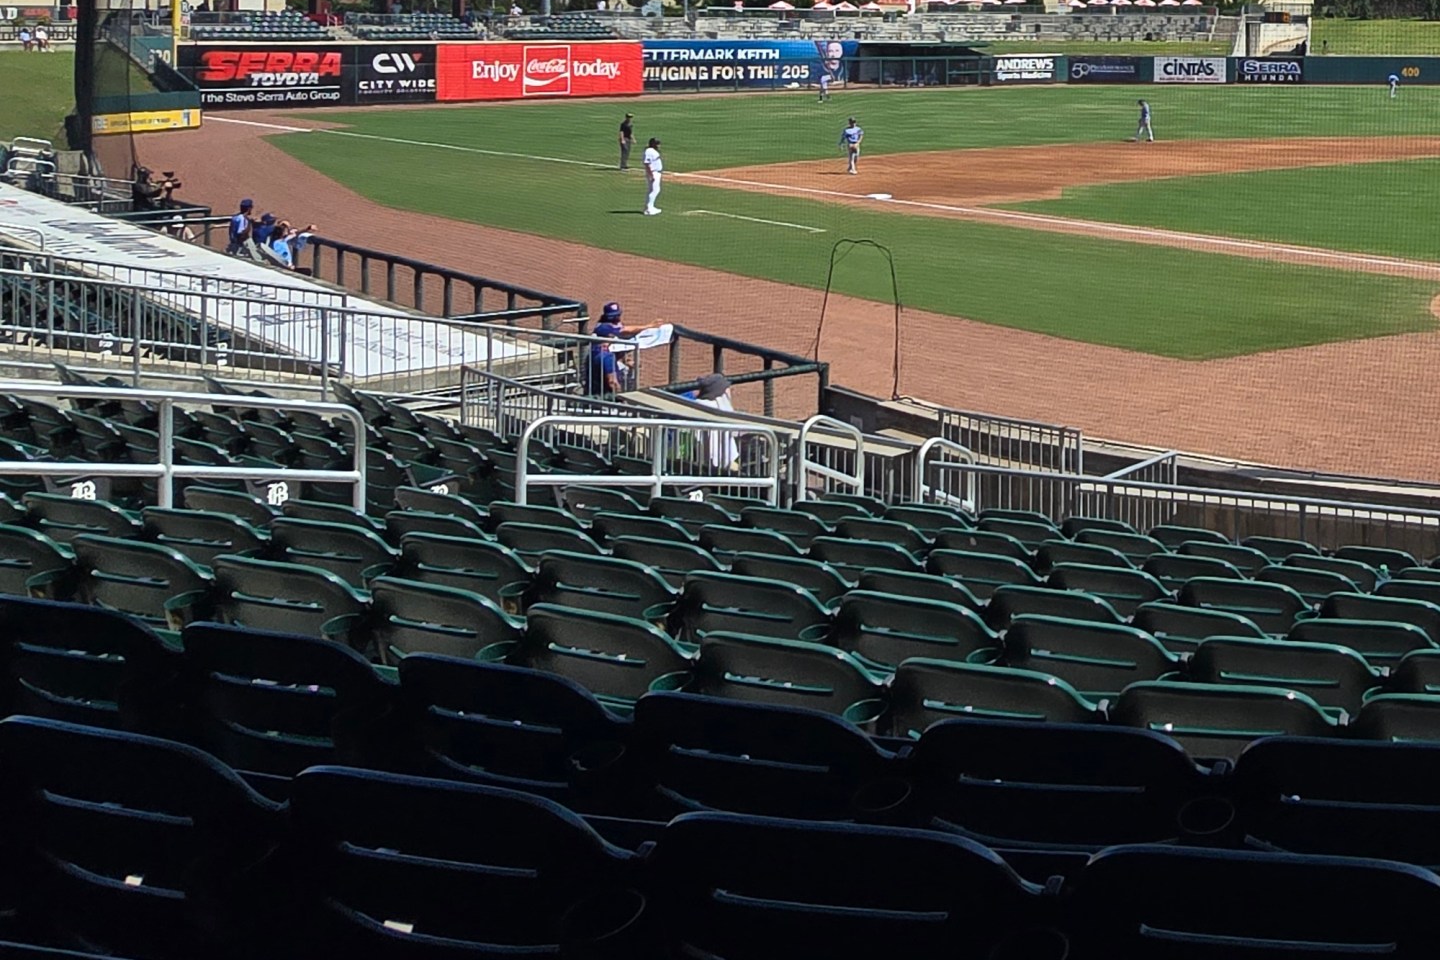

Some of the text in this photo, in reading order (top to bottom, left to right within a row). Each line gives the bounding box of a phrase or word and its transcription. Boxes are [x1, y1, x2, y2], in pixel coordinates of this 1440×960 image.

[642, 48, 780, 60] ETTERMARK KEITH
[198, 50, 342, 81] SERRA
[472, 58, 621, 82] Enjoy Coca-Cola today.
[996, 58, 1054, 70] ANDREWS
[1163, 58, 1215, 76] CINTAS
[1243, 59, 1301, 74] SERRA
[712, 65, 745, 80] FOR
[747, 65, 779, 80] THE
[781, 64, 810, 79] 205
[1245, 74, 1299, 82] HYUNDAI
[1401, 66, 1420, 78] 400
[250, 72, 320, 87] TOYOTA
[359, 78, 436, 90] CITY WIDE
[207, 93, 224, 103] the
[226, 92, 255, 103] Steve
[257, 92, 285, 102] Serra
[285, 91, 309, 102] Auto
[309, 90, 341, 102] Group
